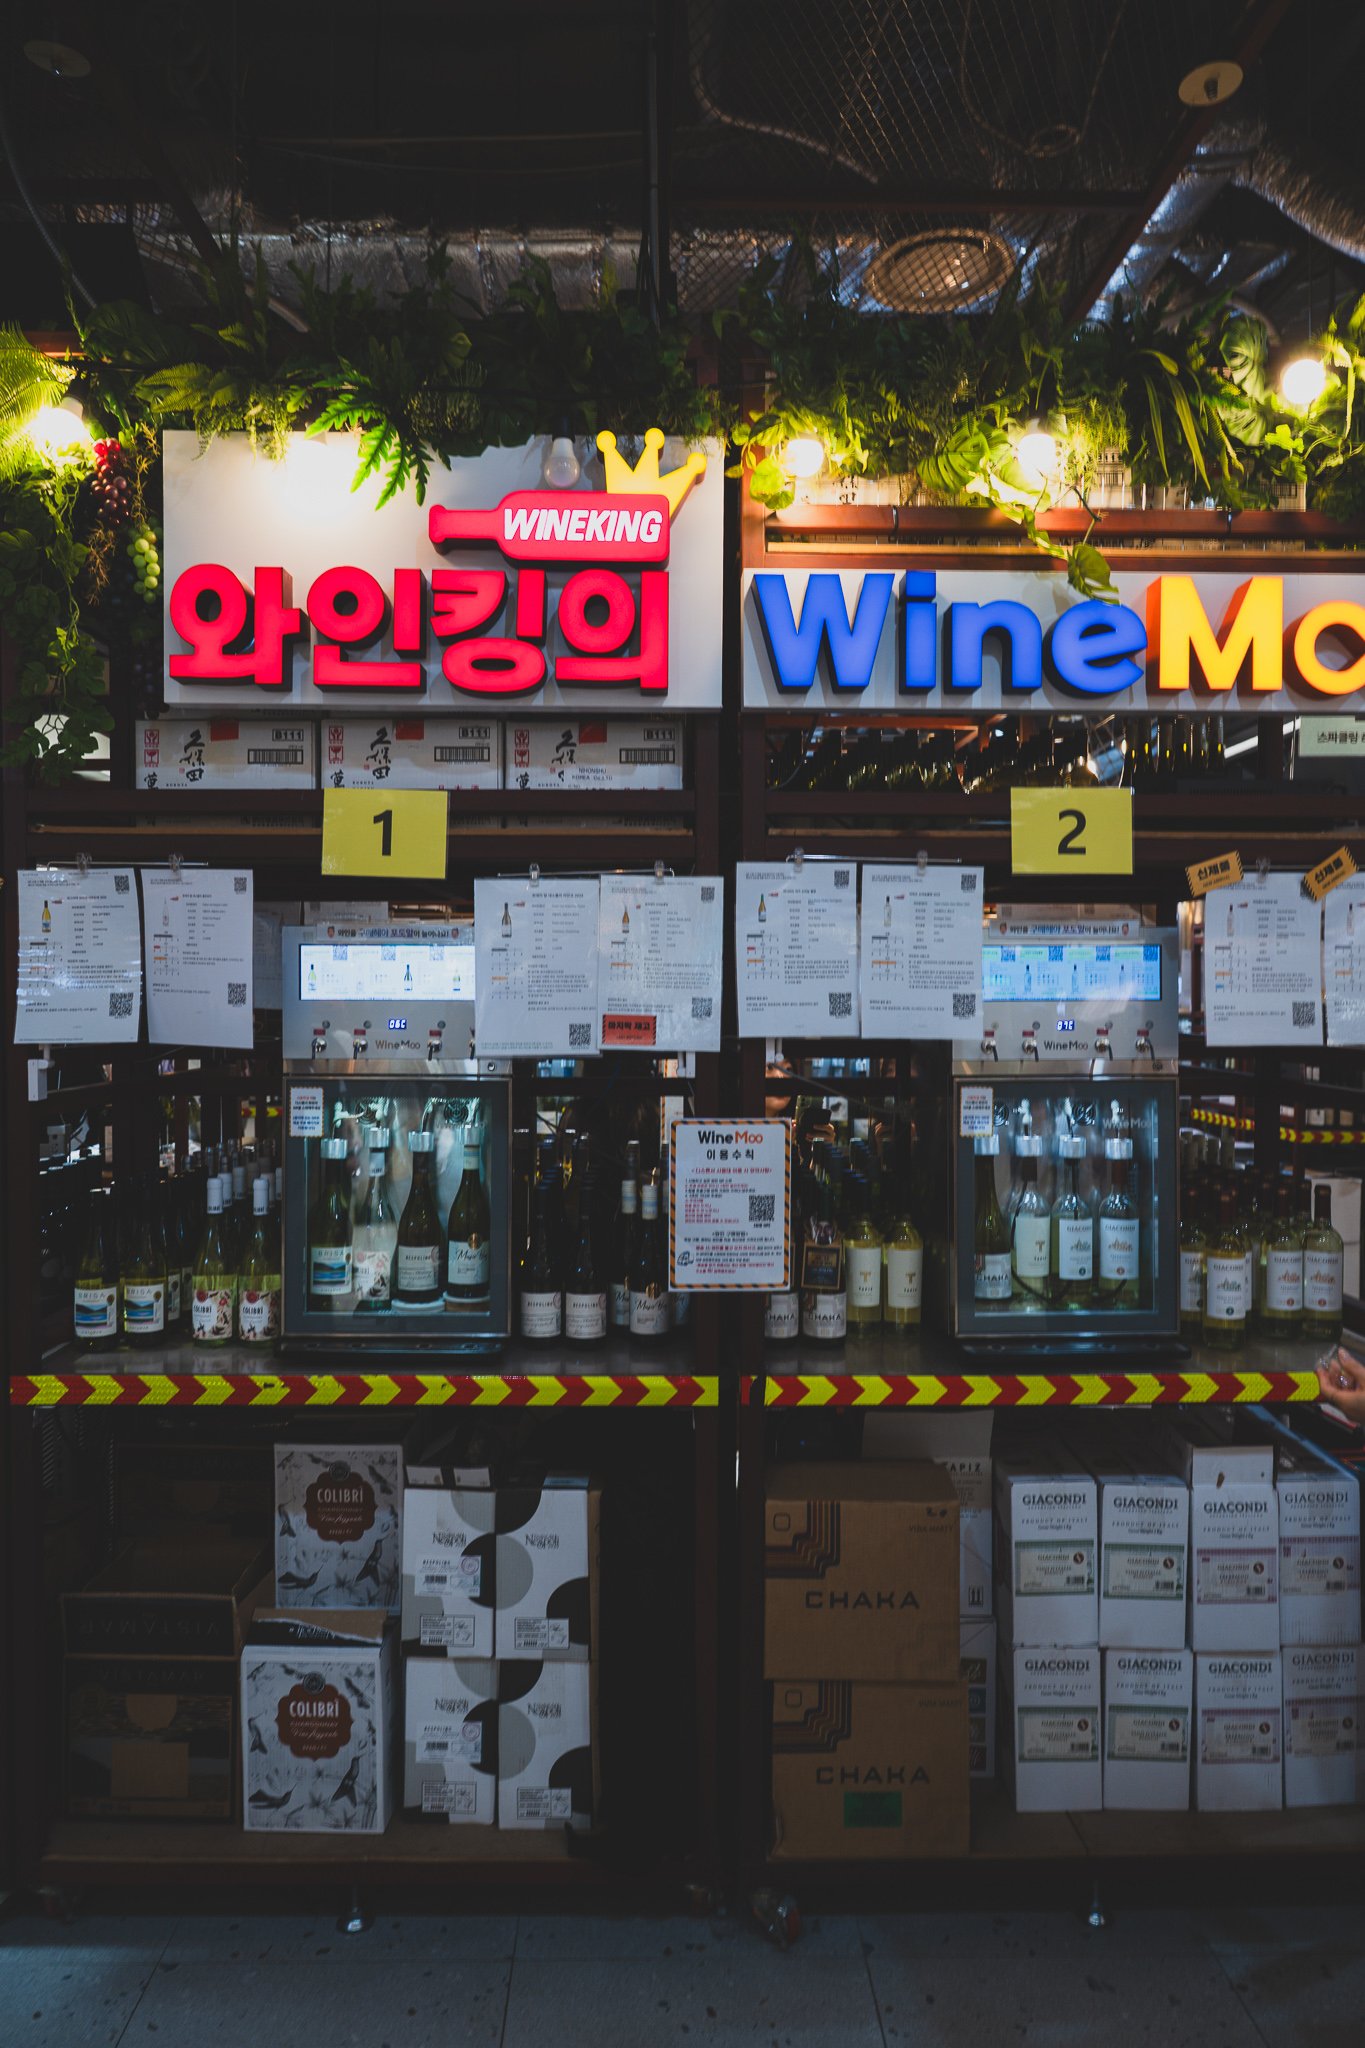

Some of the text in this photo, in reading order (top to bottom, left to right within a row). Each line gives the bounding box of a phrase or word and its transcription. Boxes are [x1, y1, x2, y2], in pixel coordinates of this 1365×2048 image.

[503, 508, 663, 544] WINEKING
[168, 562, 670, 696] 와인킹의
[372, 809, 393, 857] 1
[1057, 808, 1087, 855] 2
[1197, 860, 1231, 880] 신제품
[608, 1021, 632, 1030] 마지막
[1022, 1493, 1086, 1506] GIACONDI
[1113, 1497, 1178, 1510] GIACONDI
[1284, 1492, 1348, 1504] GIACONDI
[1203, 1501, 1268, 1513] GIACONDI
[804, 1591, 920, 1610] CHAKA
[1024, 1658, 1089, 1671] GIACONDI
[1118, 1658, 1182, 1671] GIACONDI
[1292, 1653, 1355, 1665] GIACONDI
[1209, 1661, 1272, 1674] GIACONDI
[815, 1766, 931, 1785] CHAKA
